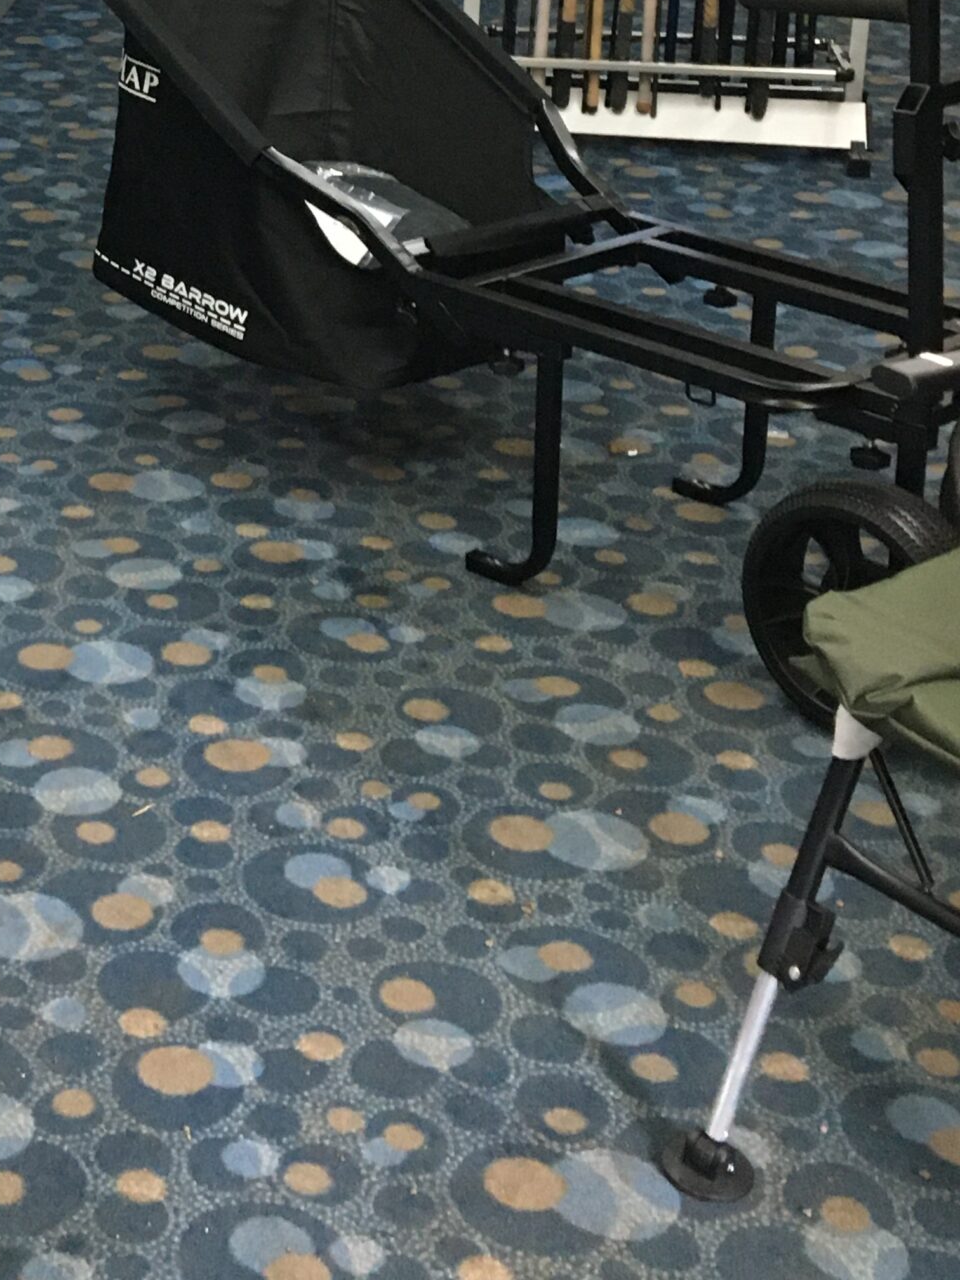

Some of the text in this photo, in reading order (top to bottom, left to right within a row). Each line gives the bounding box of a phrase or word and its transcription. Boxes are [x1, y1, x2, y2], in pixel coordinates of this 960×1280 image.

[132, 258, 249, 326] X2 BARROW
[150, 289, 245, 341] COMPETITION SERIES
